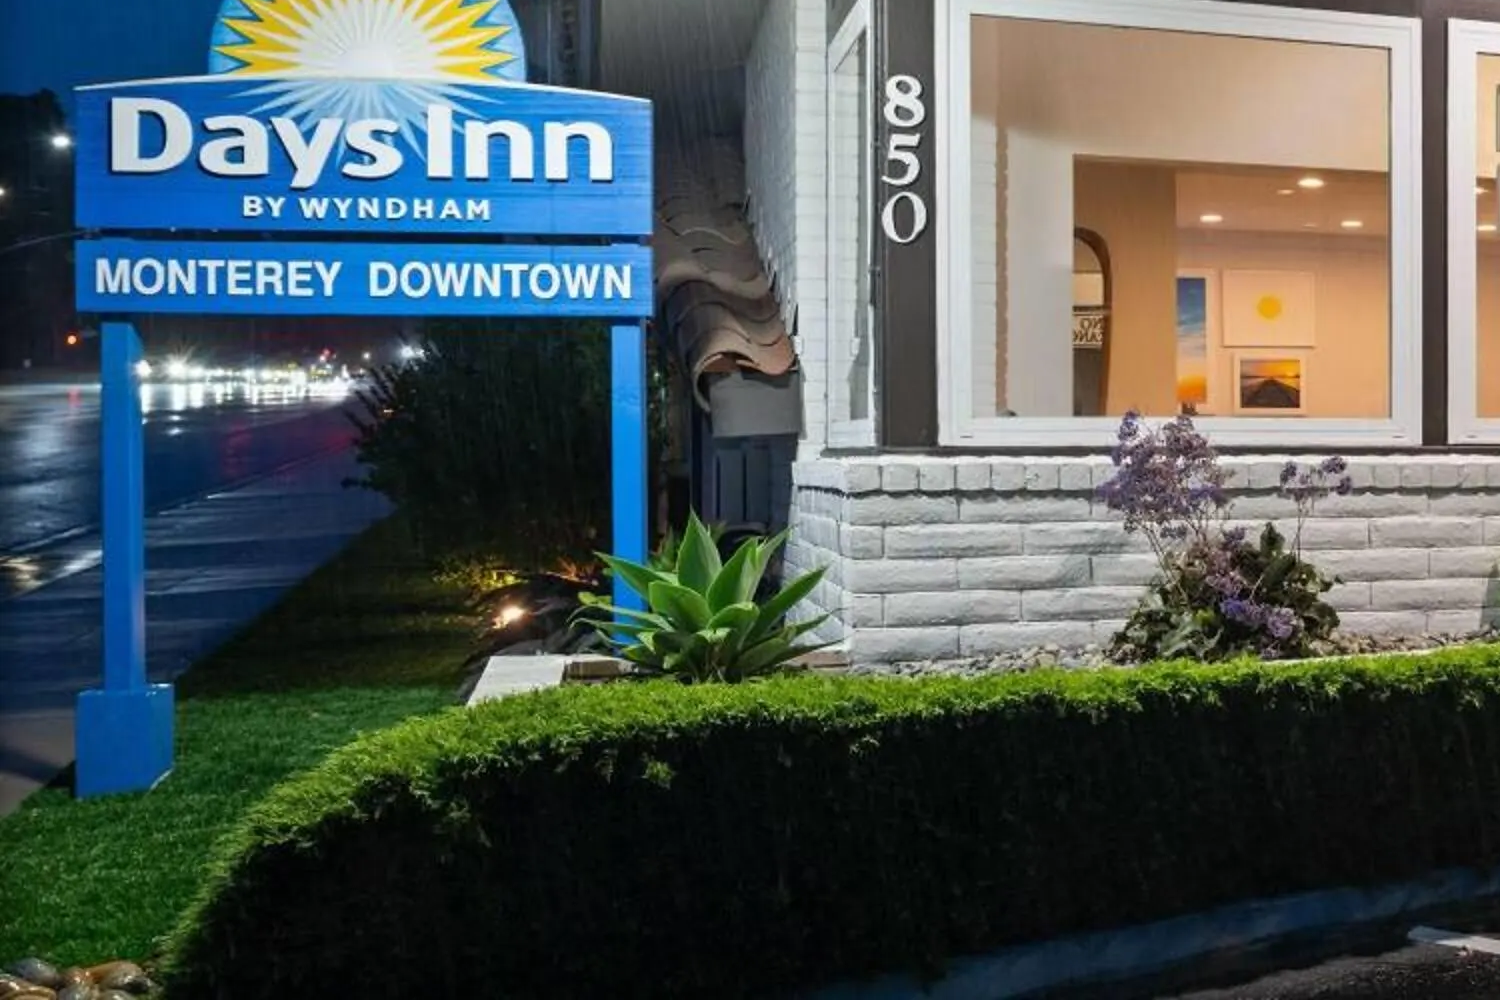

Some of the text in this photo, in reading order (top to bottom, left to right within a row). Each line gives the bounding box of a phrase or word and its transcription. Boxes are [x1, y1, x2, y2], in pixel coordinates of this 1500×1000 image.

[110, 96, 614, 188] Days Inn
[881, 75, 927, 243] 850
[243, 195, 492, 221] BY WYNDHAM
[96, 257, 633, 300] MONTEREY DOWNTOWN
